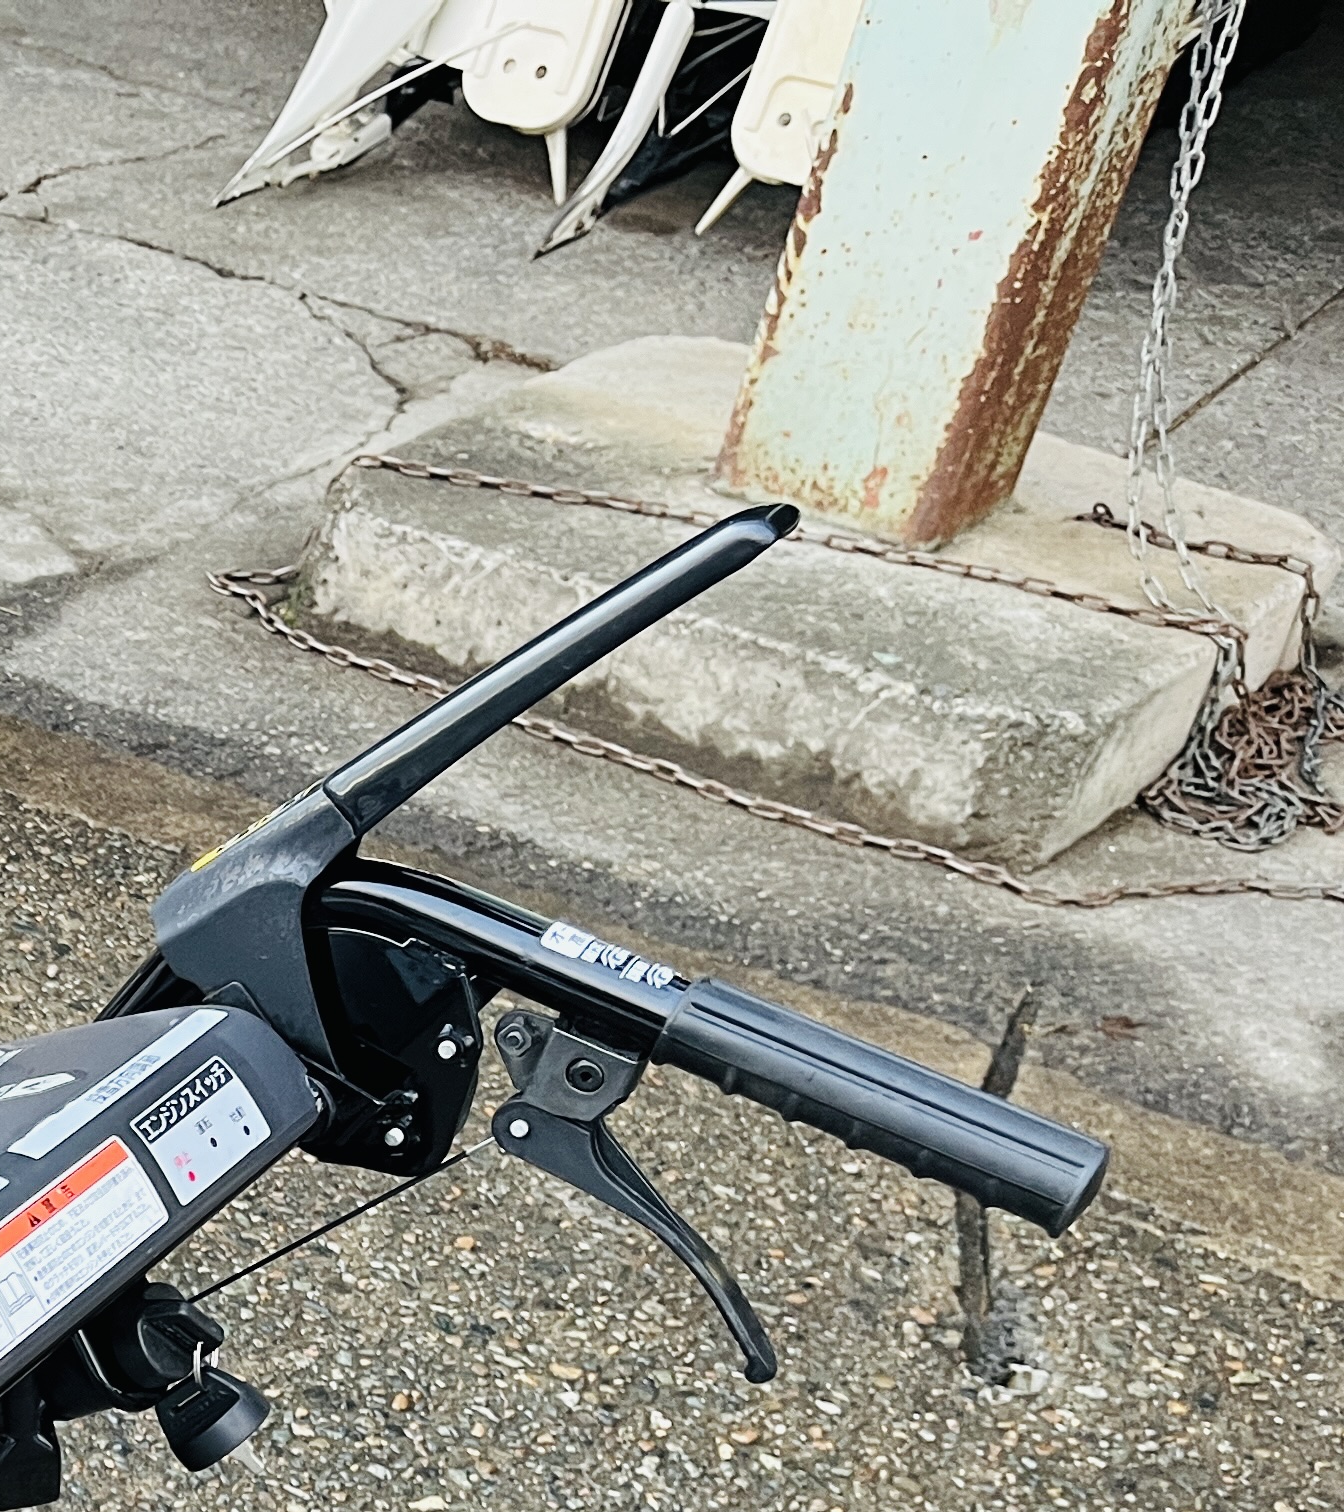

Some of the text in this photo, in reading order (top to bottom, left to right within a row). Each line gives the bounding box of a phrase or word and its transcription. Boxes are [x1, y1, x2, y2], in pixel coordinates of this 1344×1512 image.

[137, 1060, 230, 1142] エンジンスイッチ
